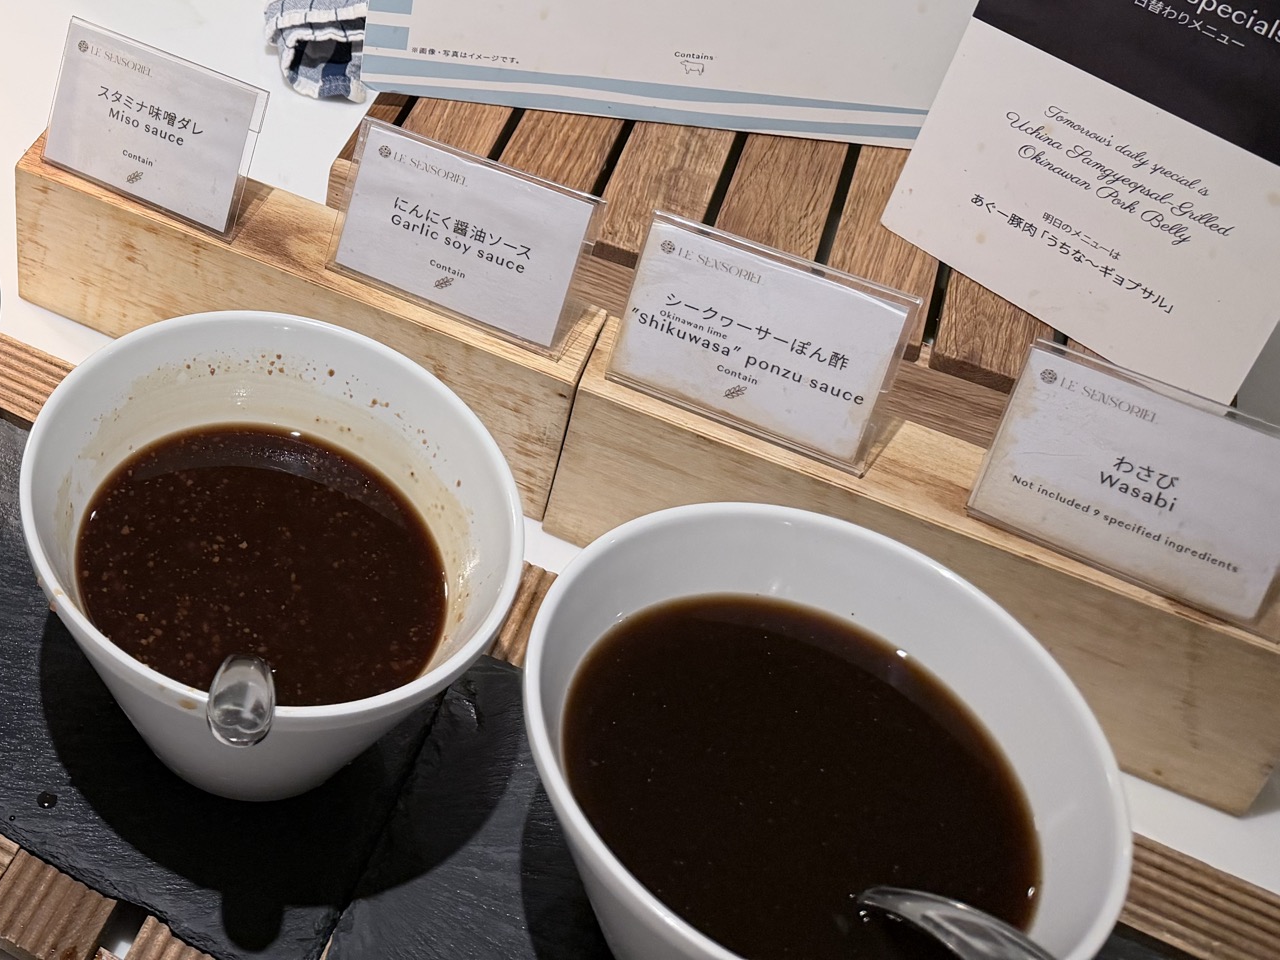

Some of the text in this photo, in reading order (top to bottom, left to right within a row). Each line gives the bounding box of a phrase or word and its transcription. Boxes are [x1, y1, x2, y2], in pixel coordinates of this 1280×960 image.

[674, 51, 714, 61] Contains
[97, 85, 204, 136] スタミナ味噌ダレ
[108, 107, 185, 146] Miso sauce
[1006, 111, 1063, 150] Uchina
[122, 149, 154, 167] Contain
[1044, 105, 1210, 197] Tomorrow's daily special is
[1018, 144, 1192, 246] Okinawan Pork Belly
[390, 213, 526, 274] Garlic soy sauce
[1041, 211, 1121, 261] 明日のメニューは
[429, 259, 466, 279] Contain
[665, 293, 850, 371] シークワーサーぽん酢
[707, 326, 728, 340] lime
[716, 364, 759, 385] Contain
[744, 352, 803, 383] ponzu
[809, 376, 865, 406] sauce
[1099, 470, 1178, 512] Wasabi
[1113, 456, 1180, 490] わさび
[1012, 474, 1240, 574] Not included 9 specified ingredients
